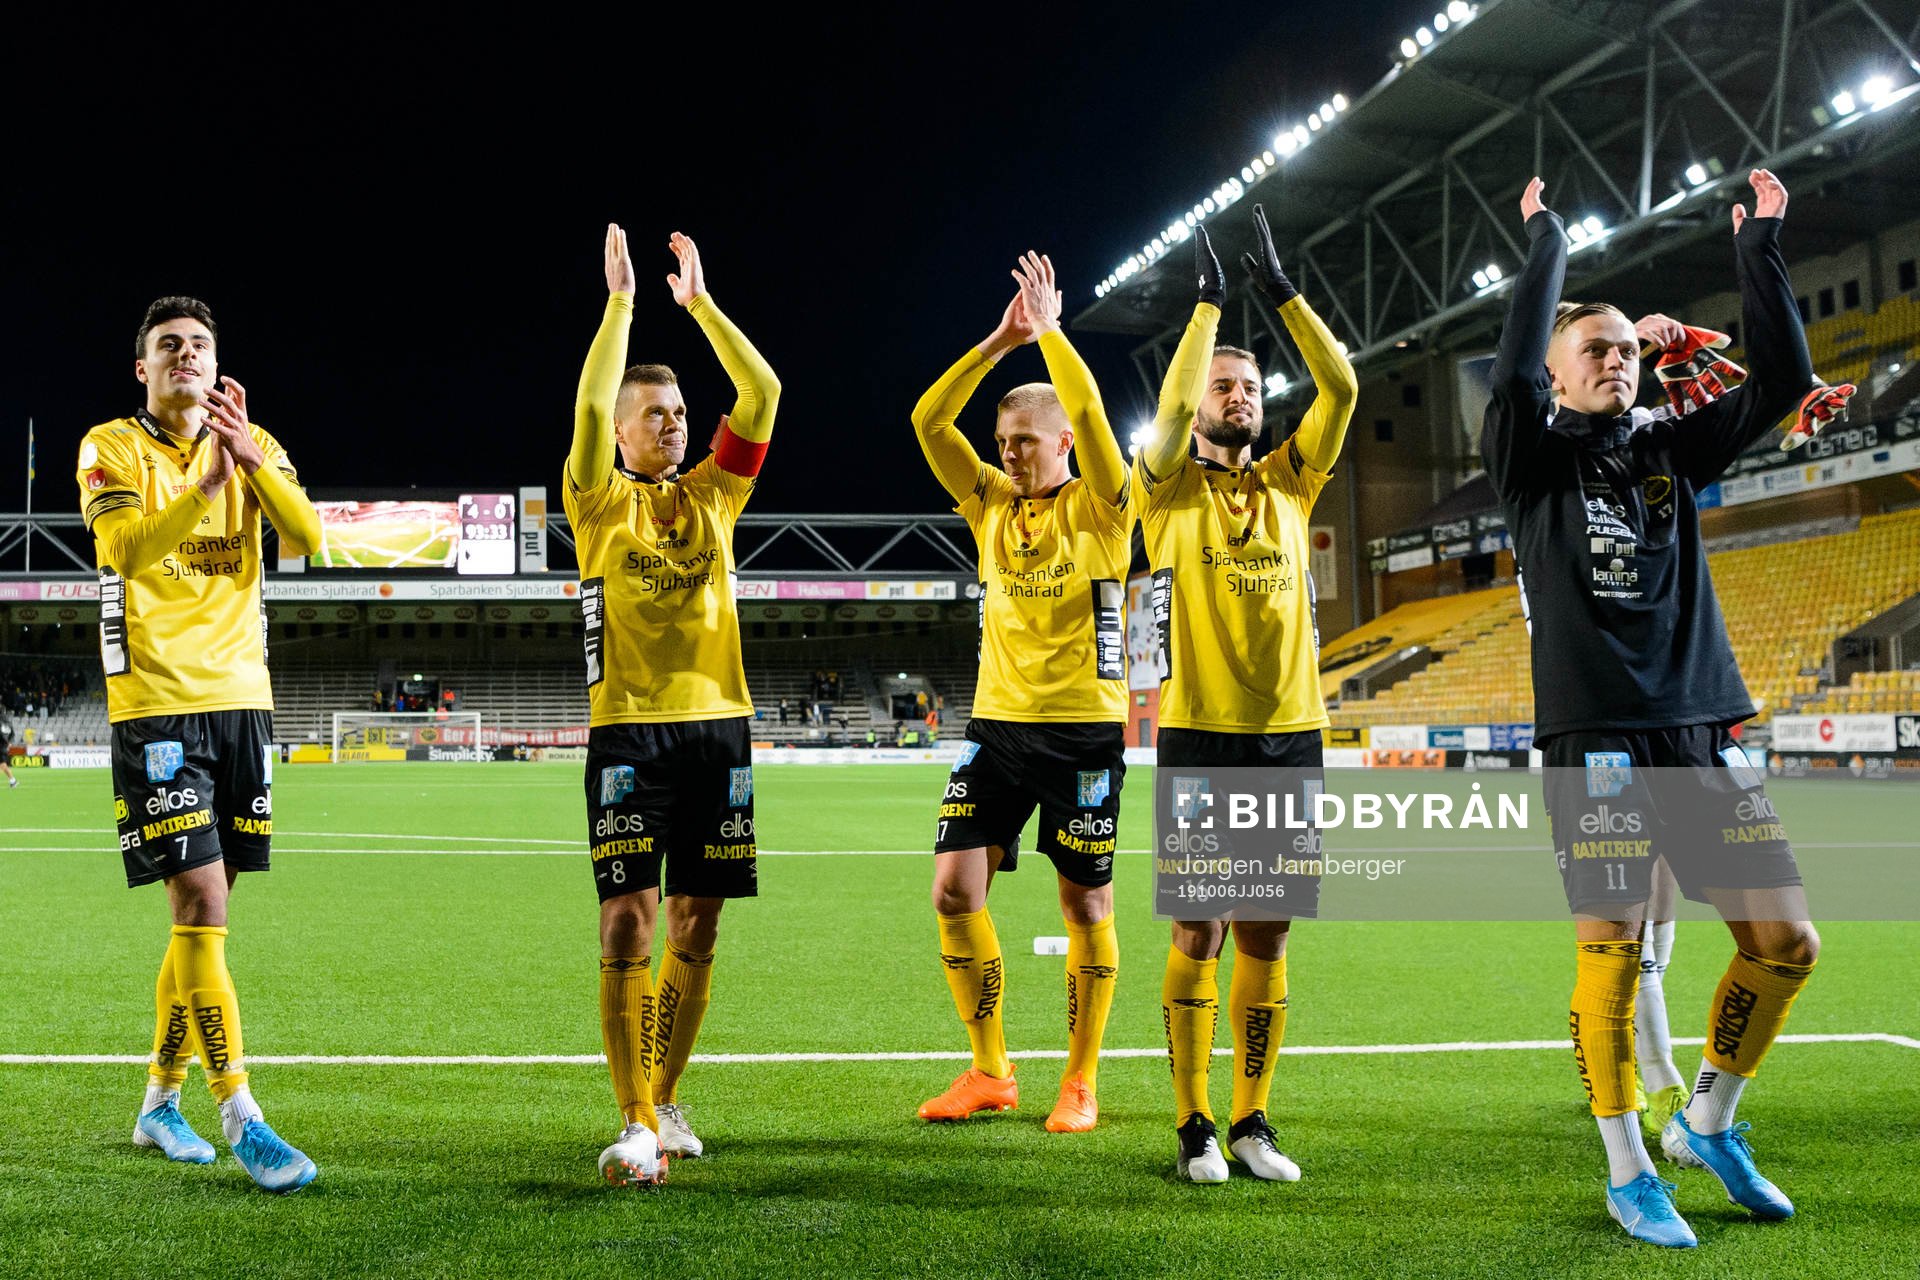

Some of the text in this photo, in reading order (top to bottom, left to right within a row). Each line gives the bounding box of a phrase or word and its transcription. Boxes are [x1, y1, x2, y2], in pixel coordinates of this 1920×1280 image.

[467, 504, 479, 519] 4
[494, 503, 507, 519] 0
[1586, 497, 1626, 518] ellos
[1657, 503, 1673, 519] 17
[465, 524, 508, 540] 93:33
[1586, 525, 1637, 540] PULSEN
[1587, 512, 1630, 531] Folks
[173, 534, 247, 555] rbanken
[520, 532, 542, 557] put
[656, 540, 689, 550] lamina
[1227, 531, 1261, 547] lamna
[628, 548, 719, 573] Sparanke
[1012, 548, 1039, 558] amina
[1201, 547, 1290, 569] Spabank
[162, 558, 243, 580] Sjuhärad
[994, 561, 1075, 583] arbanken
[1592, 567, 1638, 582] lamina
[47, 584, 99, 598] PULS
[266, 584, 375, 598] rbanken Sjuhärad
[430, 583, 559, 598] Sparbanken Sjuhärad
[1002, 582, 1063, 598] uhärad
[1098, 631, 1122, 672] put
[429, 748, 495, 762] Simplicty.
[1590, 767, 1628, 781] EKT
[1591, 781, 1613, 794] IV
[145, 787, 199, 816] ellos
[1735, 792, 1778, 821] ello
[143, 808, 211, 841] RAMIRENT
[233, 816, 272, 835] RAMI
[596, 809, 644, 837] ellos
[720, 813, 755, 838] ello
[1068, 813, 1113, 836] ellos
[1579, 805, 1642, 834] ellos
[1165, 827, 1219, 853] ellos
[1292, 828, 1322, 853] ello
[1722, 824, 1788, 844] RAMIRE
[175, 836, 189, 860] 7
[592, 837, 653, 862] RAMIRENT
[704, 843, 756, 860] RAMIRE
[1572, 840, 1651, 859] RAMIRENT
[612, 860, 626, 884] 8
[1604, 863, 1627, 890] 11
[974, 956, 1000, 1020] FRISTADS
[654, 978, 682, 1070] FRISTADS
[1713, 981, 1758, 1063] FRISTADS
[196, 1006, 230, 1072] FRISTADS
[1245, 1007, 1274, 1079] FRISTADS
